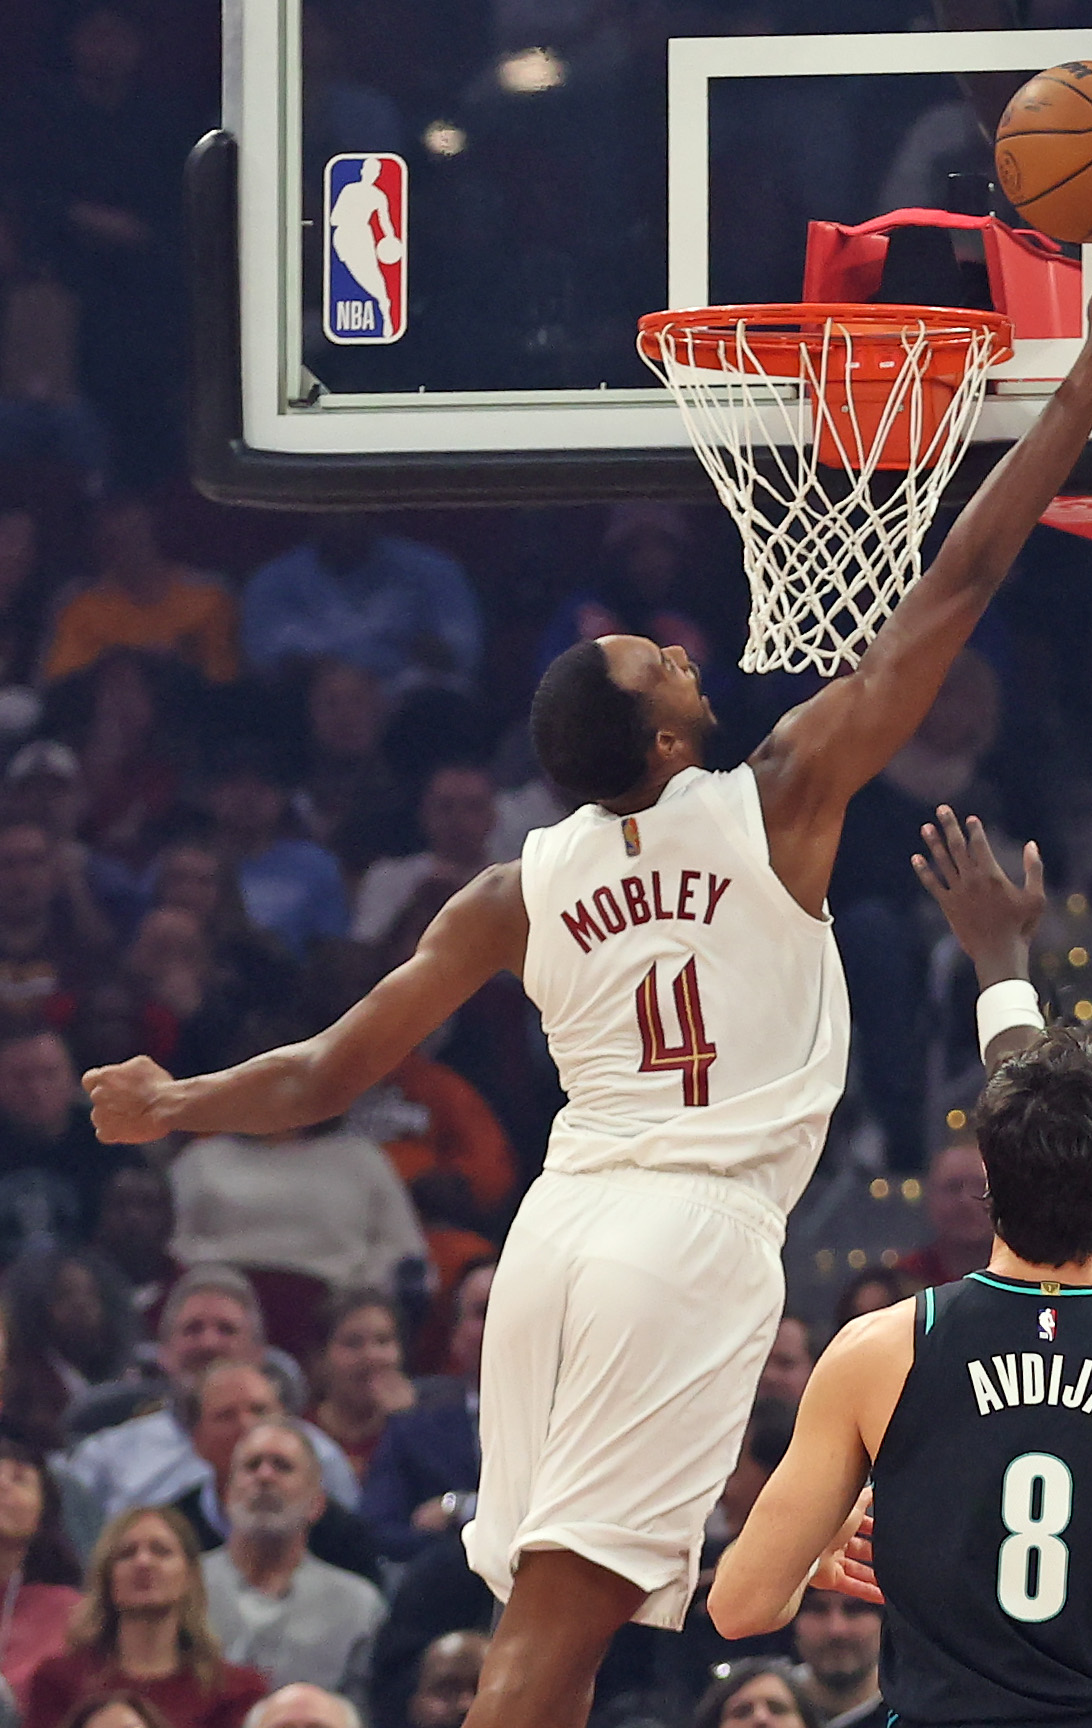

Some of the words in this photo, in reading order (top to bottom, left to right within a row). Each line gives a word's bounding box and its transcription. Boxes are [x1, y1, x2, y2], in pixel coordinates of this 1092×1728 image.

[336, 300, 375, 331] NBA
[560, 870, 732, 954] MOBLEY
[635, 954, 717, 1107] 4
[997, 1451, 1074, 1623] 8
